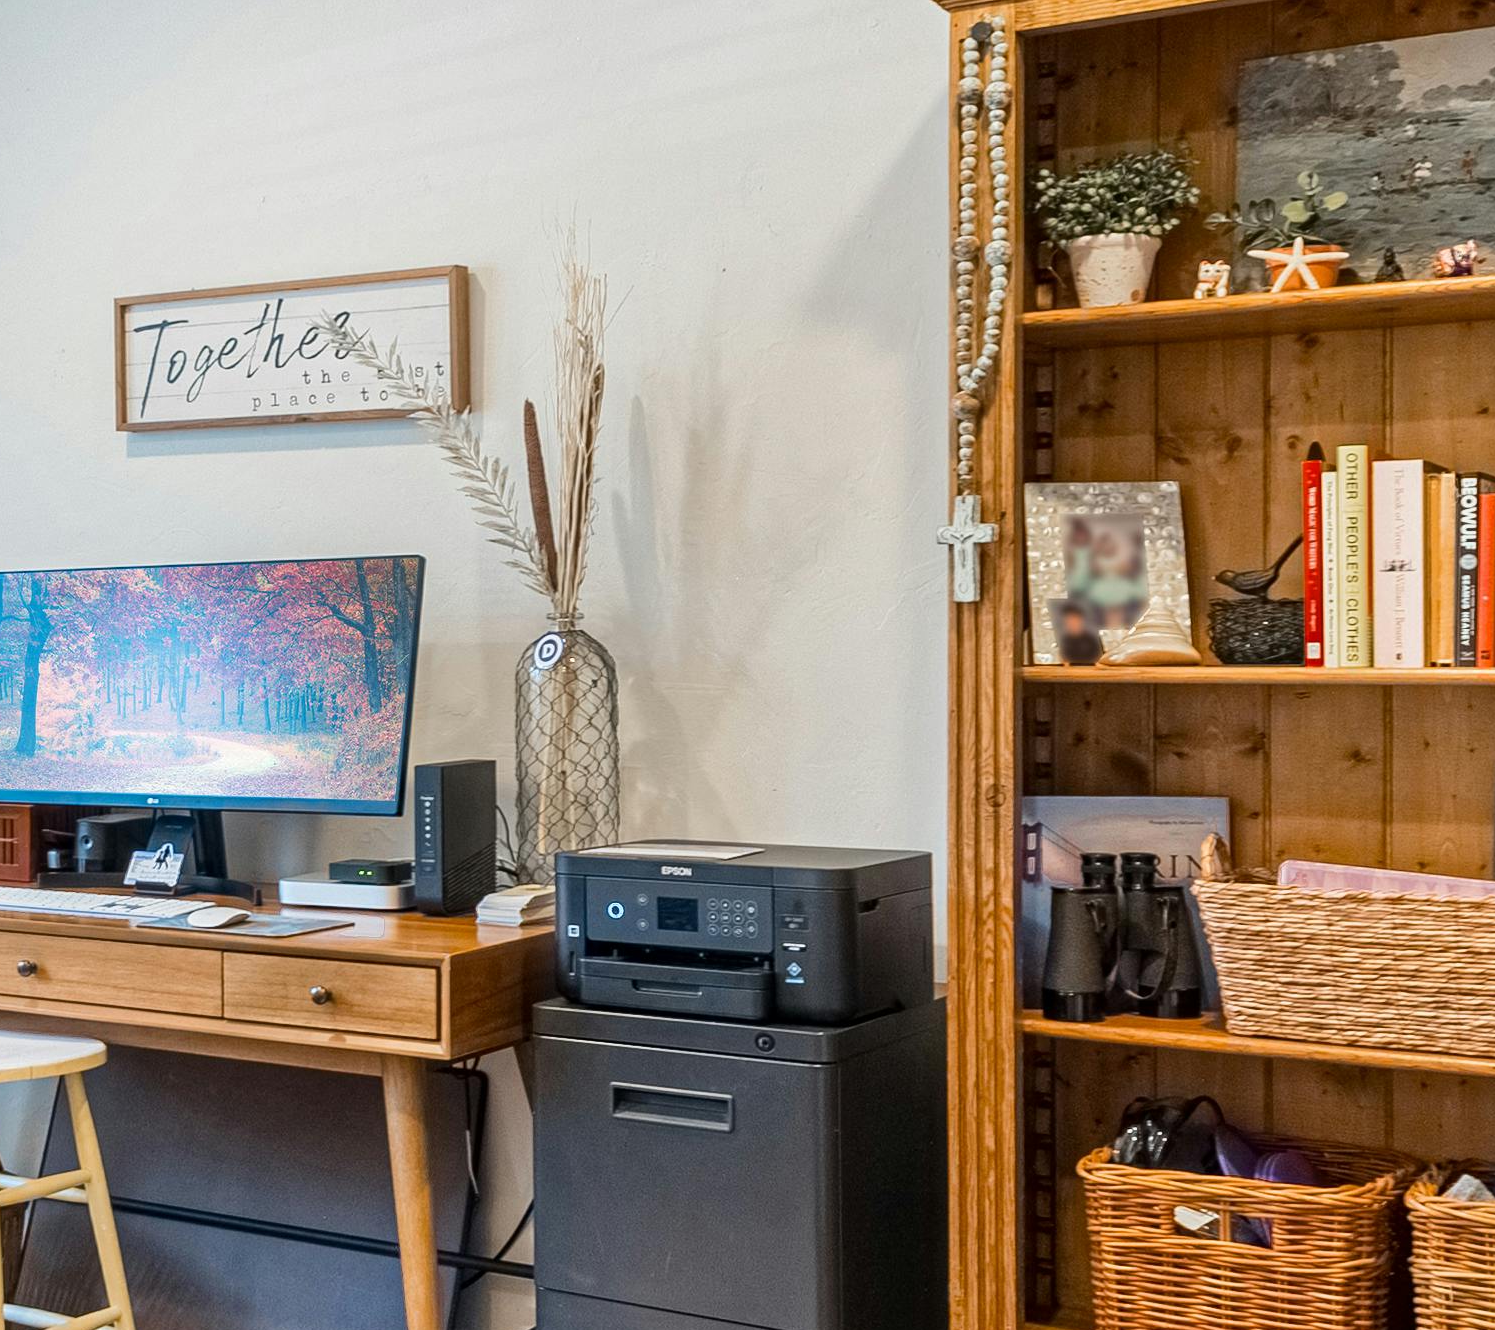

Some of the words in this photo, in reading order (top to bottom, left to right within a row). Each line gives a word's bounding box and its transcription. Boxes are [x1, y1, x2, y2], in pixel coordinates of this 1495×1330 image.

[133, 298, 370, 418] Together
[302, 369, 352, 385] the
[252, 393, 336, 412] place
[360, 386, 389, 402] to
[1345, 452, 1358, 500] OTHER
[1395, 469, 1405, 486] The
[1395, 487, 1405, 510] Book
[1460, 477, 1477, 550] BEOWULF
[1395, 511, 1405, 522] of
[1346, 516, 1359, 583] PEOPLE'S
[1395, 523, 1406, 555] Virtues
[1395, 574, 1406, 607] William
[1461, 574, 1470, 609] SEAMUS
[1346, 597, 1359, 662] CLOTHES
[1394, 616, 1406, 648] Bennett
[1460, 611, 1470, 646] HEANEY
[661, 865, 692, 876] EPSON
